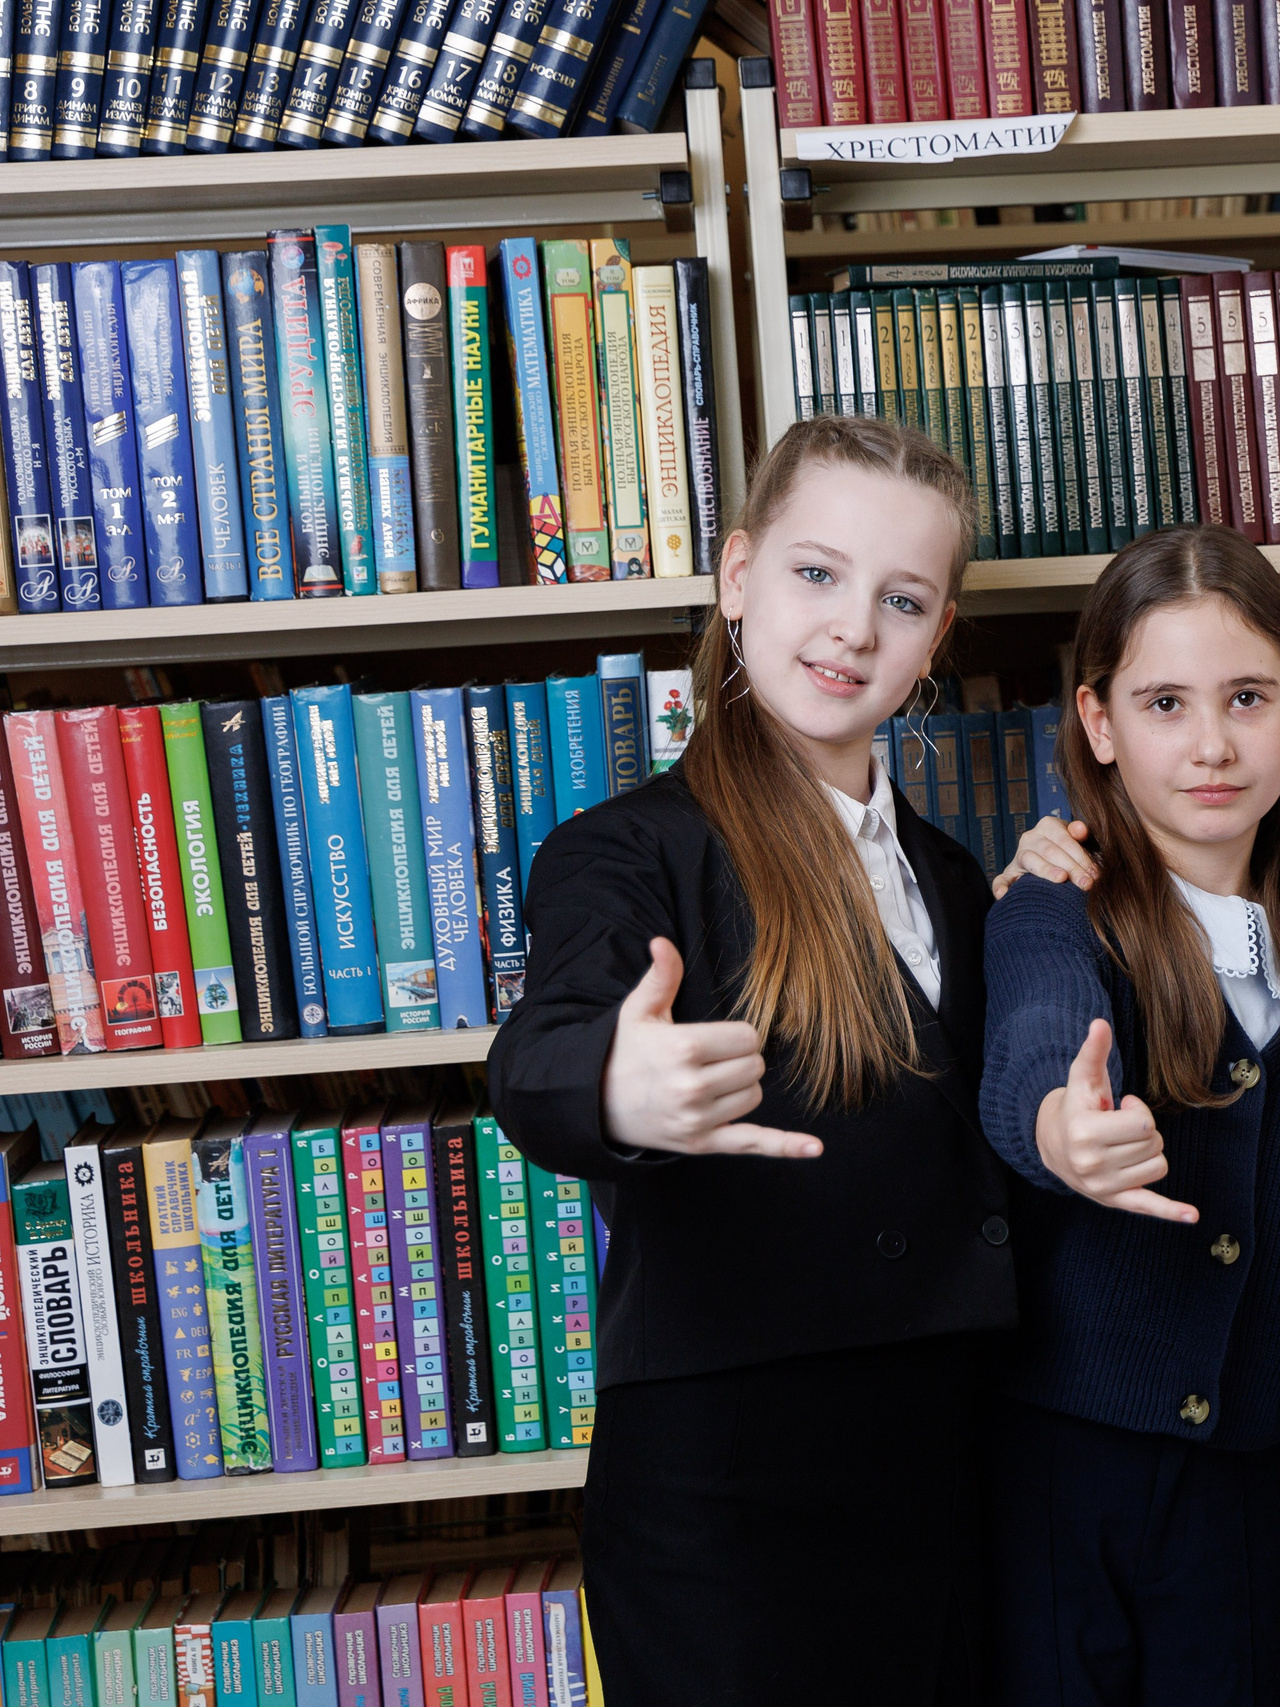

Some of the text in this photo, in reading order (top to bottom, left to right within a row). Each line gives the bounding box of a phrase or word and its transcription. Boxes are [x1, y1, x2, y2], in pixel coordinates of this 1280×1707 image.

[160, 74, 181, 95] 11
[209, 72, 233, 94] 12
[257, 71, 279, 92] 13
[303, 67, 328, 90] 14
[349, 67, 373, 89] 15
[399, 65, 422, 89] 16
[446, 60, 472, 82] 17
[494, 60, 517, 83] 18
[530, 62, 576, 88] РОССИЯ
[1092, 11, 1111, 100] ХРЕСТОМАТИЯ
[1138, 6, 1156, 95] ХРЕСТОМАТИЯ
[1183, 5, 1201, 94] ХРЕСТОМАТИЯ
[1232, 4, 1249, 93] ХРЕСТОМАТИЯ
[24, 80, 38, 100] 8
[71, 77, 85, 98] 9
[116, 77, 141, 99] 10
[405, 297, 440, 306] АФРИКА
[518, 288, 541, 388] МАТЕМАТИКА
[881, 327, 889, 343] 2
[902, 325, 911, 342] 2
[968, 323, 977, 340] 2
[1228, 311, 1237, 327] 5
[1259, 312, 1268, 328] 5
[0, 281, 22, 398] ЭНЦИКЛОПЕДИЯ
[38, 283, 60, 400] ЭНЦИКЛОПЕДИЯ
[281, 275, 316, 417] ЭРУДИТА
[372, 260, 394, 443] СОВРЕМЕННАЯ ЭНЦИКЛОПЕДИЯ
[689, 303, 705, 405] СЛОВАРЬ-СПРАВОЧНИК
[323, 278, 355, 531] БОЛЬШАЯ ИЛЛЮСТРИРОВАННАЯ
[461, 300, 490, 548] ГУМАНИТАРНЫЕ НАУКИ
[561, 333, 582, 491] ПОЛНАЯ ЭНЦИКЛОПЕДИЯ
[574, 337, 593, 486] БЫТА РУССКОГО НАРОДА
[606, 331, 626, 489] ПОЛНАЯ ЭНЦИКЛОПЕДИЯ
[616, 335, 636, 484] БЫТА РУССКОГО НАРОДА
[648, 304, 679, 498] ЭНЦИКЛОПЕДИЯ
[9, 408, 27, 505] ТОЛКОВЫЙ СЛОВАРЬ
[52, 410, 70, 508] ТОЛКОВЫЙ СЛОВАРЬ
[238, 319, 283, 580] ВСЕ СТРАНЫ МИРА
[693, 417, 717, 538] ЕСТЕСТВОЗНАНИЕ
[111, 501, 123, 519] 1
[161, 490, 177, 507] 2
[208, 463, 231, 549] ЧЕЛОВЕК
[296, 454, 313, 533] БОЛЬШАЯ
[308, 427, 330, 558] ЭНЦИКЛОПЕДИЯ
[513, 702, 534, 815] ЭНЦИКЛОПЕДИЯ
[564, 690, 587, 789] ИЗОБРЕТЕНИЯ
[611, 688, 638, 791] ЛОВАРЬ
[81, 720, 132, 966] ЭНЦИКЛОПЕДИЯ ДЛЯ ДЕТЕЙ
[137, 793, 168, 931] БЕЗОПАСНОСТЬ
[182, 800, 214, 916] ЭКОЛОГИЯ
[272, 706, 318, 995] БОЛЬШОЙ СПРАВОЧНИК ПО ГЕОГРАФИИ
[376, 705, 416, 949] ЭНЦИКЛОПЕДИЯ ДЛЯ ДЕТЕЙ
[426, 815, 444, 857] МИР
[24, 736, 87, 1030] ЭНЦИКЛОПЕДИЯ ДЛЯ ДЕТЕЙ
[244, 882, 261, 910] ДЛЯ
[327, 834, 356, 949] ИСКУССТВО
[428, 864, 457, 971] ДУХОВНЫЙ
[447, 842, 470, 942] ЧЕЛОВЕКА
[498, 867, 517, 947] ФИЗИКА
[247, 917, 274, 1032] ЭНЦИКЛОПЕДИЯ
[114, 1024, 152, 1037] ГЕОГРАФИЯ
[80, 1193, 101, 1266] ИСТОРИКА
[154, 1185, 169, 1234] КРАТКИЙ
[165, 1160, 182, 1233] СПРАВОЧНИК
[178, 1162, 195, 1231] ШКОЛЬНИКА
[259, 1165, 287, 1272] ЛИТЕРАТУРА
[27, 1250, 49, 1364] ЭНЦИКЛОПЕДИЧЕСКИЙ
[42, 1246, 77, 1363] СЛОВАРЬ
[172, 1308, 188, 1319] ENG
[219, 1231, 258, 1453] ЭНЦИКЛОПЕДИЯ ДЛЯ
[270, 1280, 296, 1358] РУССКАЯ
[462, 1291, 477, 1358] справочник
[39, 1369, 80, 1379] ФИЛОСОФИЯ
[134, 1316, 155, 1381] справочник
[177, 1348, 192, 1359] FR
[42, 1384, 79, 1395] ЛИТЕРАТУРА
[143, 1384, 157, 1439] Краткий
[467, 1361, 480, 1413] Краткий
[219, 1641, 232, 1694] Справочник
[230, 1639, 242, 1693] школьника
[305, 1632, 316, 1685] Справочник
[314, 1630, 327, 1685] школьника
[512, 1610, 524, 1663] Справочник
[523, 1609, 535, 1662] школьника
[103, 1651, 114, 1705] Справочник
[112, 1649, 124, 1704] школьника
